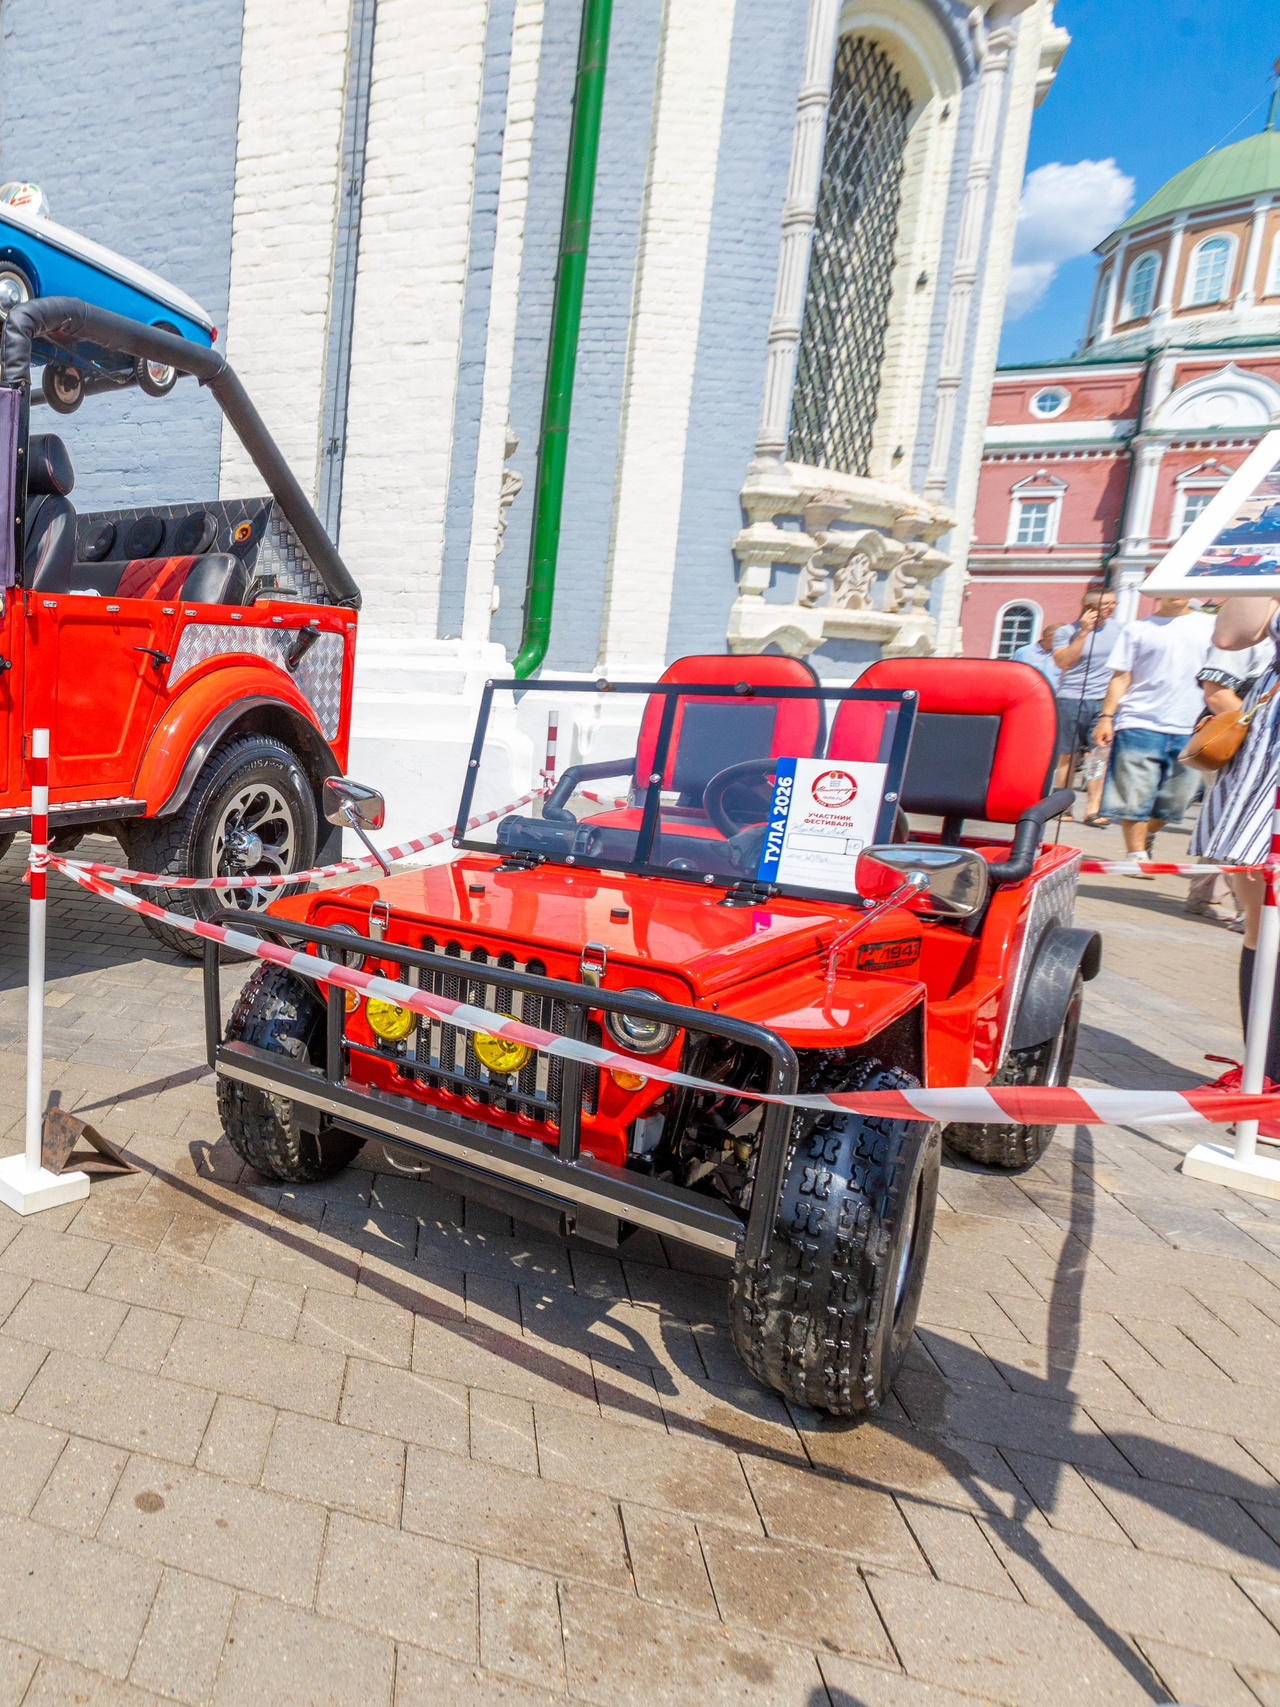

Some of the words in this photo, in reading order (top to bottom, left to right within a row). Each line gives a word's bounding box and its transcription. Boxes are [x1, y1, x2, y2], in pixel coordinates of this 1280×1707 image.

[773, 776, 793, 816] 2026
[803, 818, 854, 828] ФЕСТИВАЛЯ
[808, 812, 852, 821] УЧАСТНИК
[763, 819, 786, 864] ТУЛА
[885, 943, 918, 960] 1941
